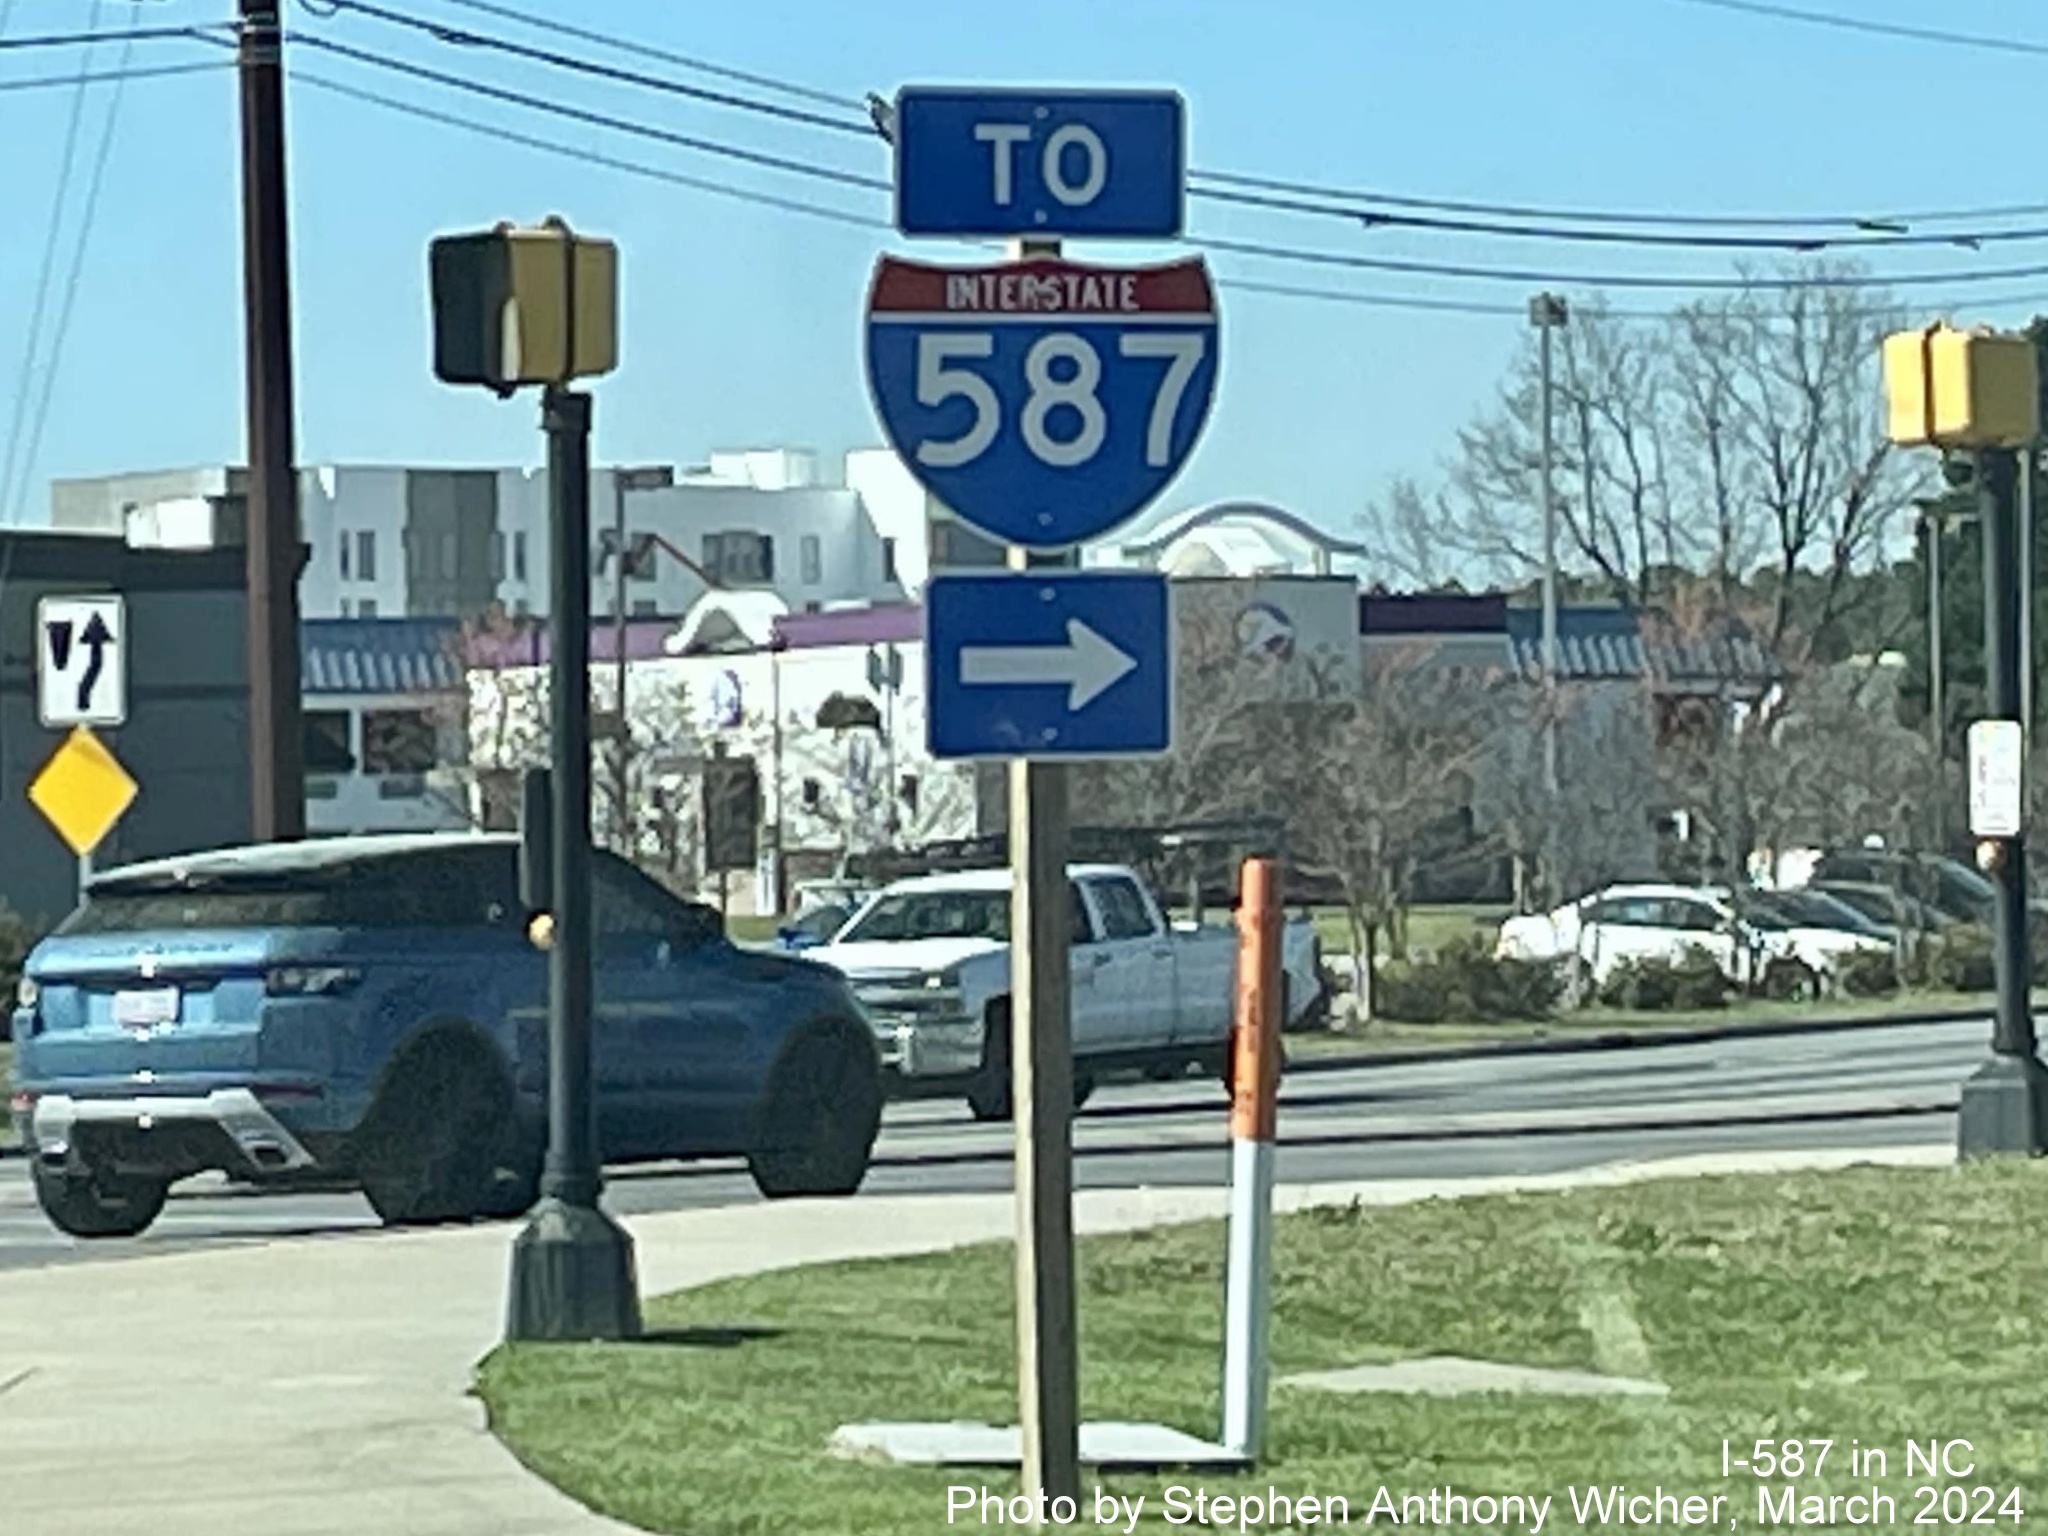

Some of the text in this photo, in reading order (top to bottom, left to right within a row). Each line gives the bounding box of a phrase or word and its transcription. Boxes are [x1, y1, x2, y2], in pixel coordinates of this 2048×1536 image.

[973, 122, 1109, 207] TO
[946, 273, 1140, 311] INTERSTATE
[915, 332, 1206, 467] 587
